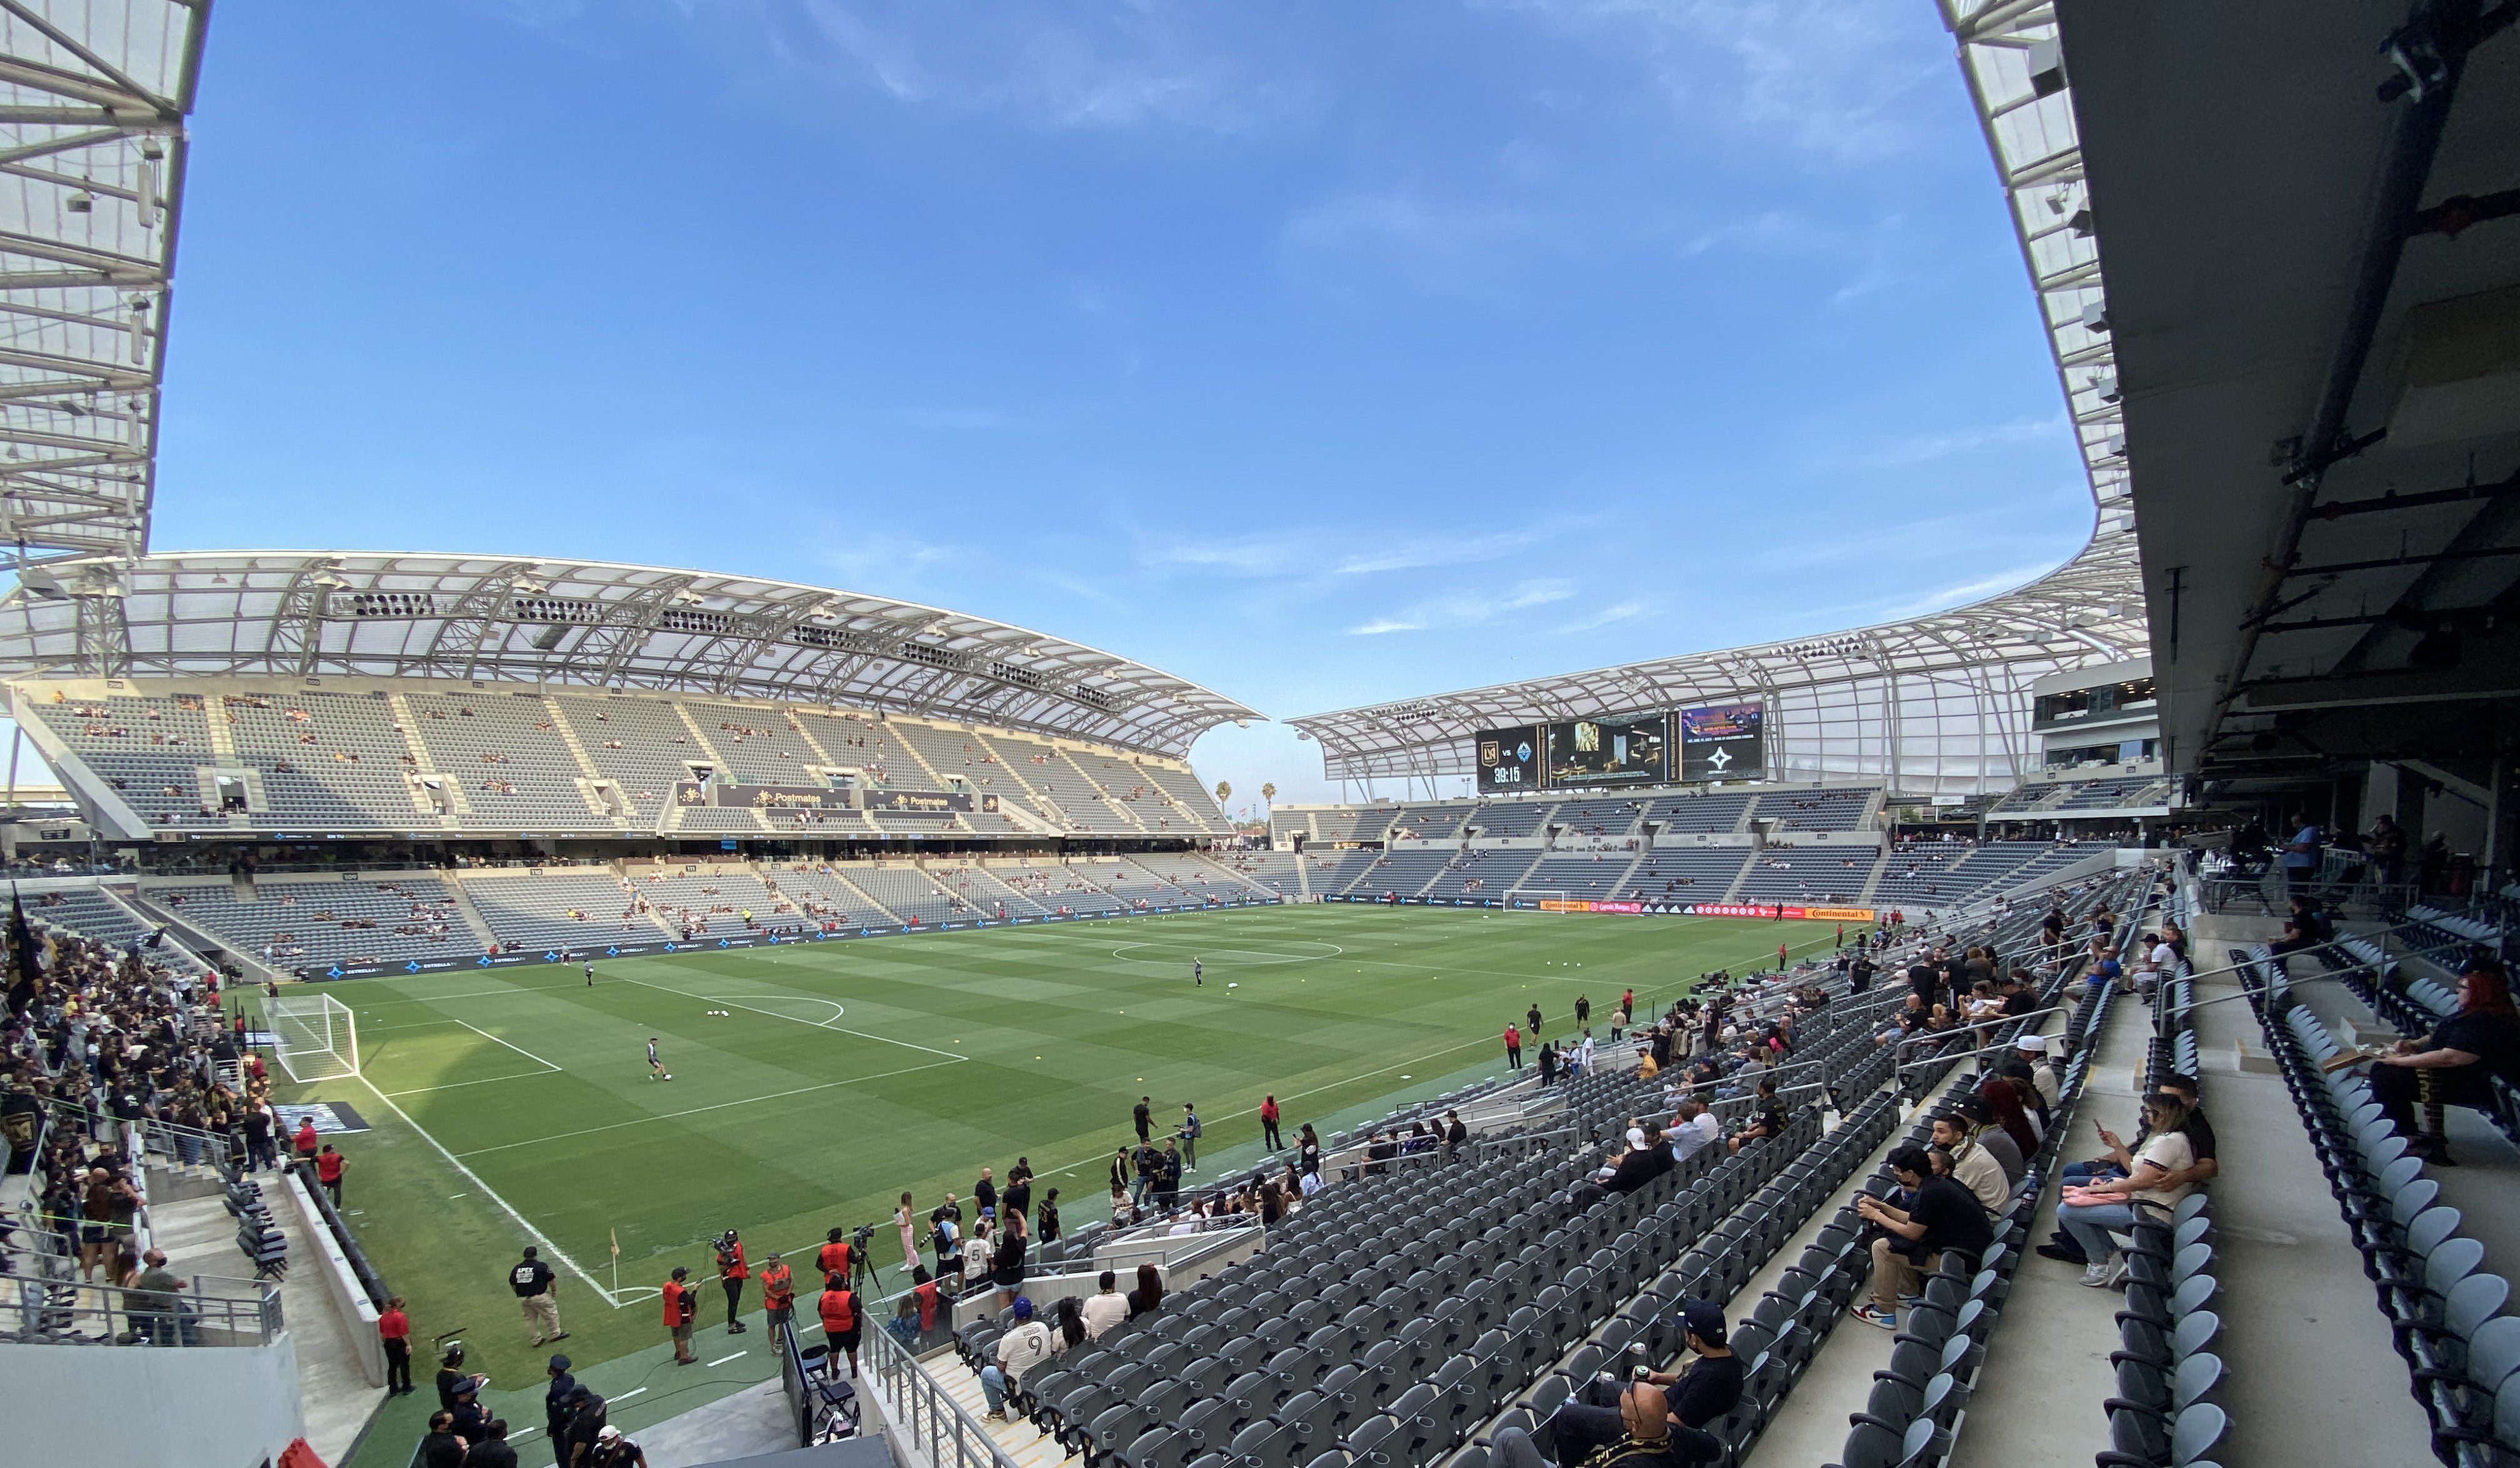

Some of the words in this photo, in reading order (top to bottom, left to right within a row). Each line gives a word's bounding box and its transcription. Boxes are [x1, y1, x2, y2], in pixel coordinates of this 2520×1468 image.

[1494, 767, 1520, 783] 39:15
[776, 793, 821, 802] Postmates
[911, 797, 948, 805] Postmates
[1812, 909, 1858, 917] Continental
[971, 1249, 980, 1262] 5
[1023, 1327, 1040, 1337] ROSSI
[1028, 1335, 1042, 1357] 9
